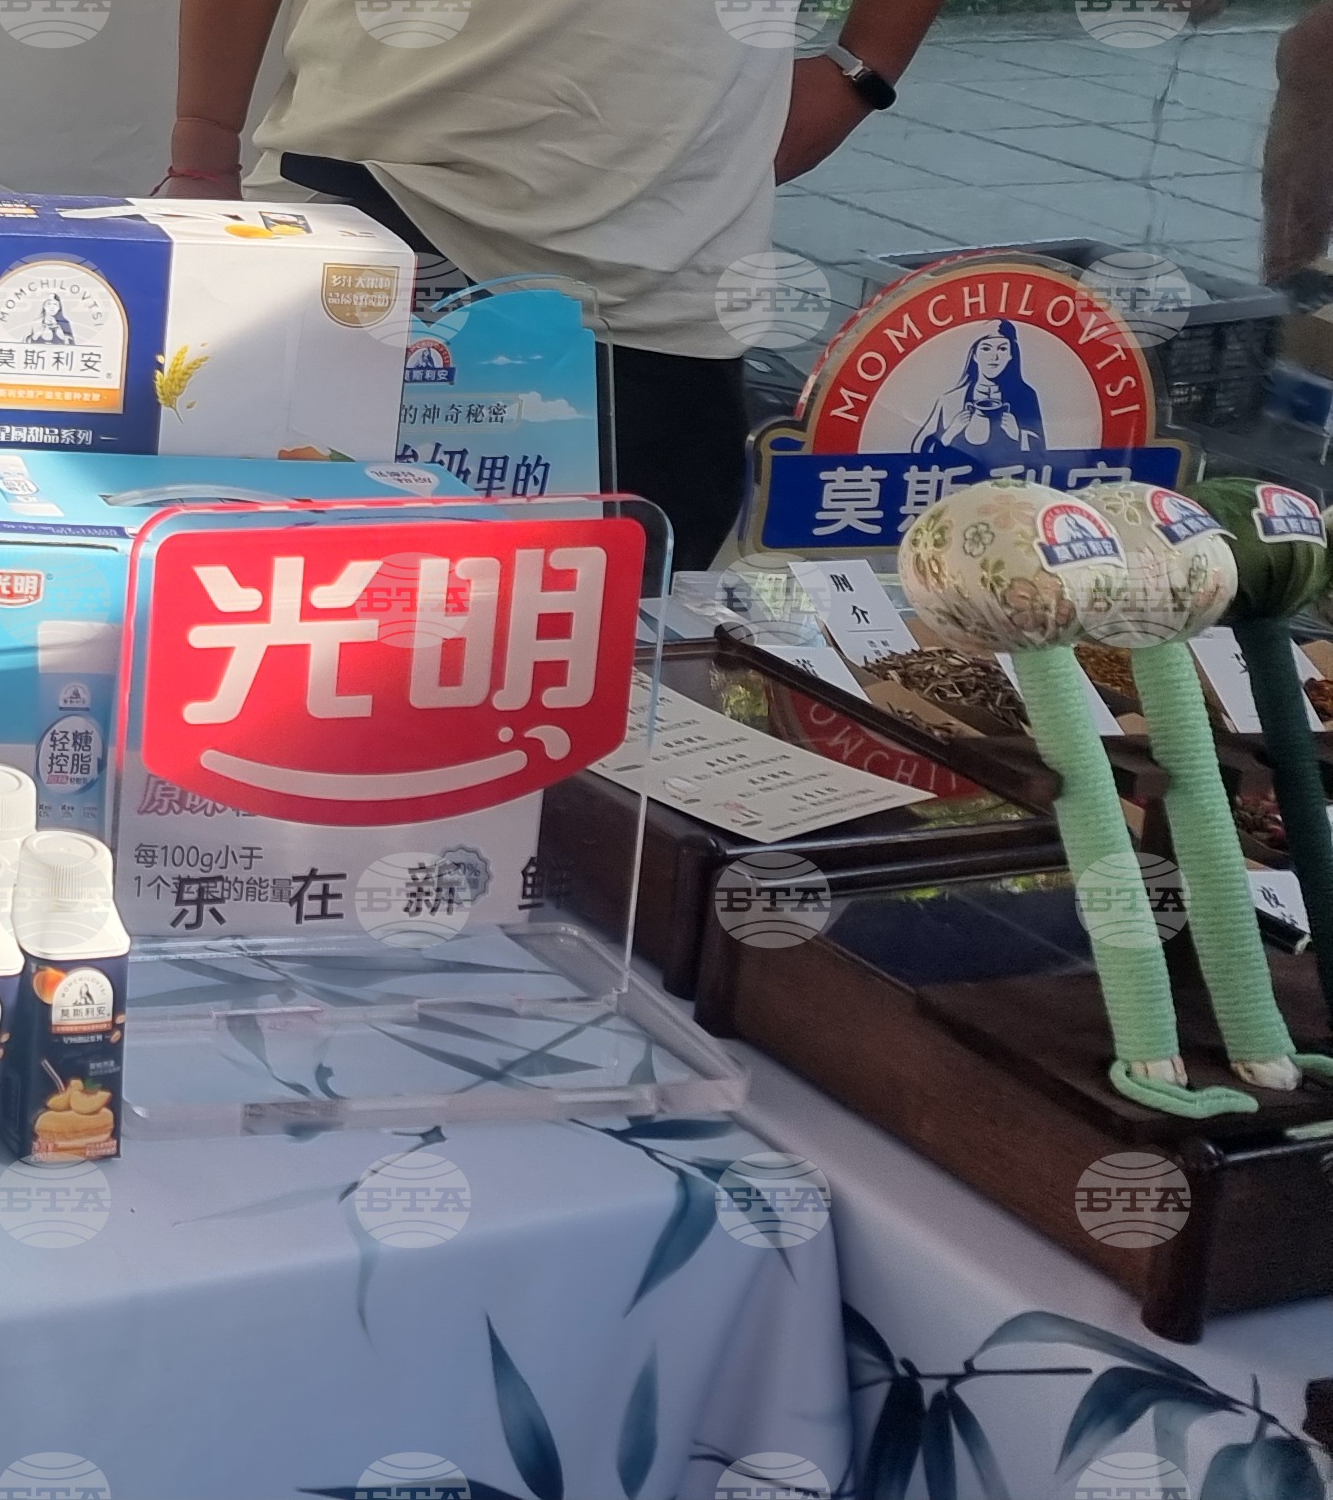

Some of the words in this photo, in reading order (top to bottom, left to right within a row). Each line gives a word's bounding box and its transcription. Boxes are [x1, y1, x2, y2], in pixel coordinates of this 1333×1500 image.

[830, 281, 1141, 424] MOMCHILOVTSI
[183, 546, 608, 725] 光明
[50, 730, 93, 752] 轻糖
[48, 752, 92, 775] 控脂
[134, 843, 264, 872] 每100g小于
